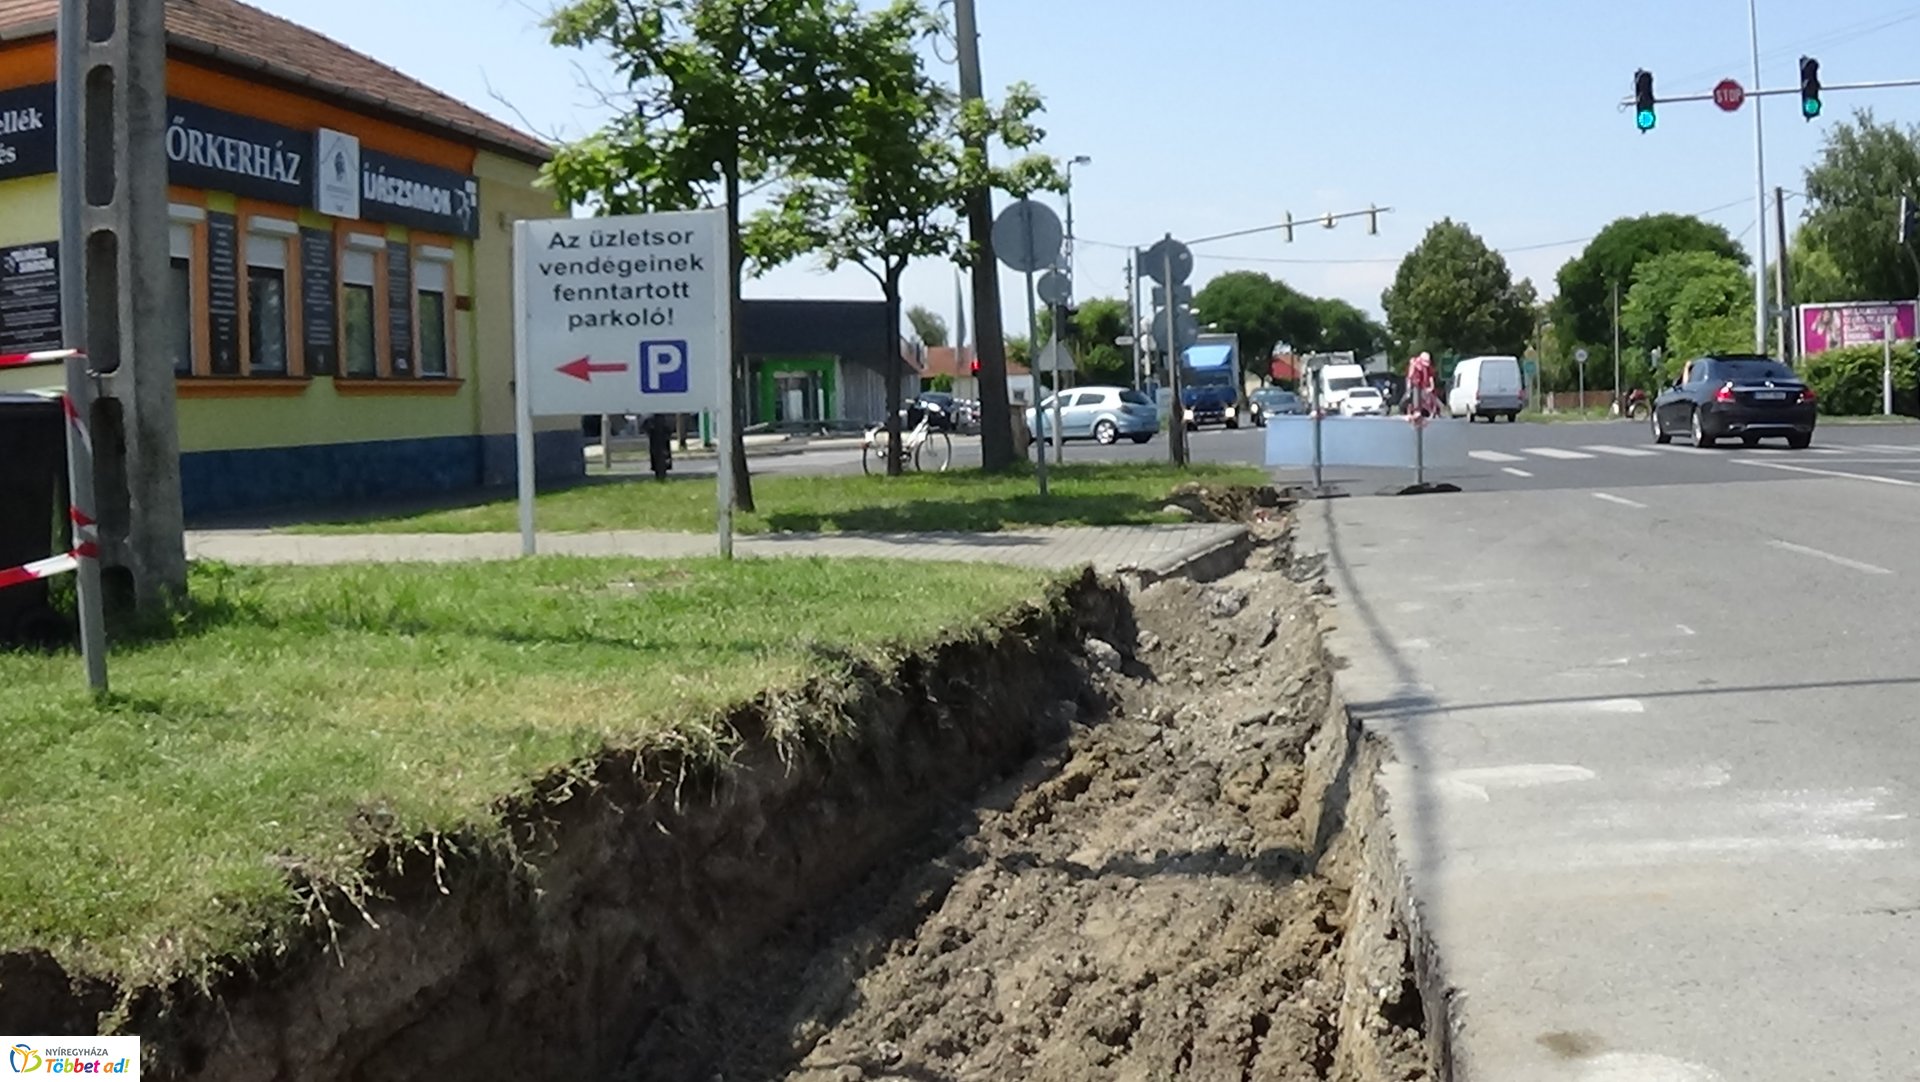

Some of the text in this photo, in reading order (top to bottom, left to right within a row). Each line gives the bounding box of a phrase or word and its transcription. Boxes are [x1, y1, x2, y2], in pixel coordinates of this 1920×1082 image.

[1716, 88, 1742, 103] STOP
[548, 229, 694, 249] Az üzletsor
[538, 253, 704, 278] vendégeinek
[553, 281, 690, 302] fenntartott
[568, 307, 674, 332] parkoló!
[647, 344, 682, 390] P
